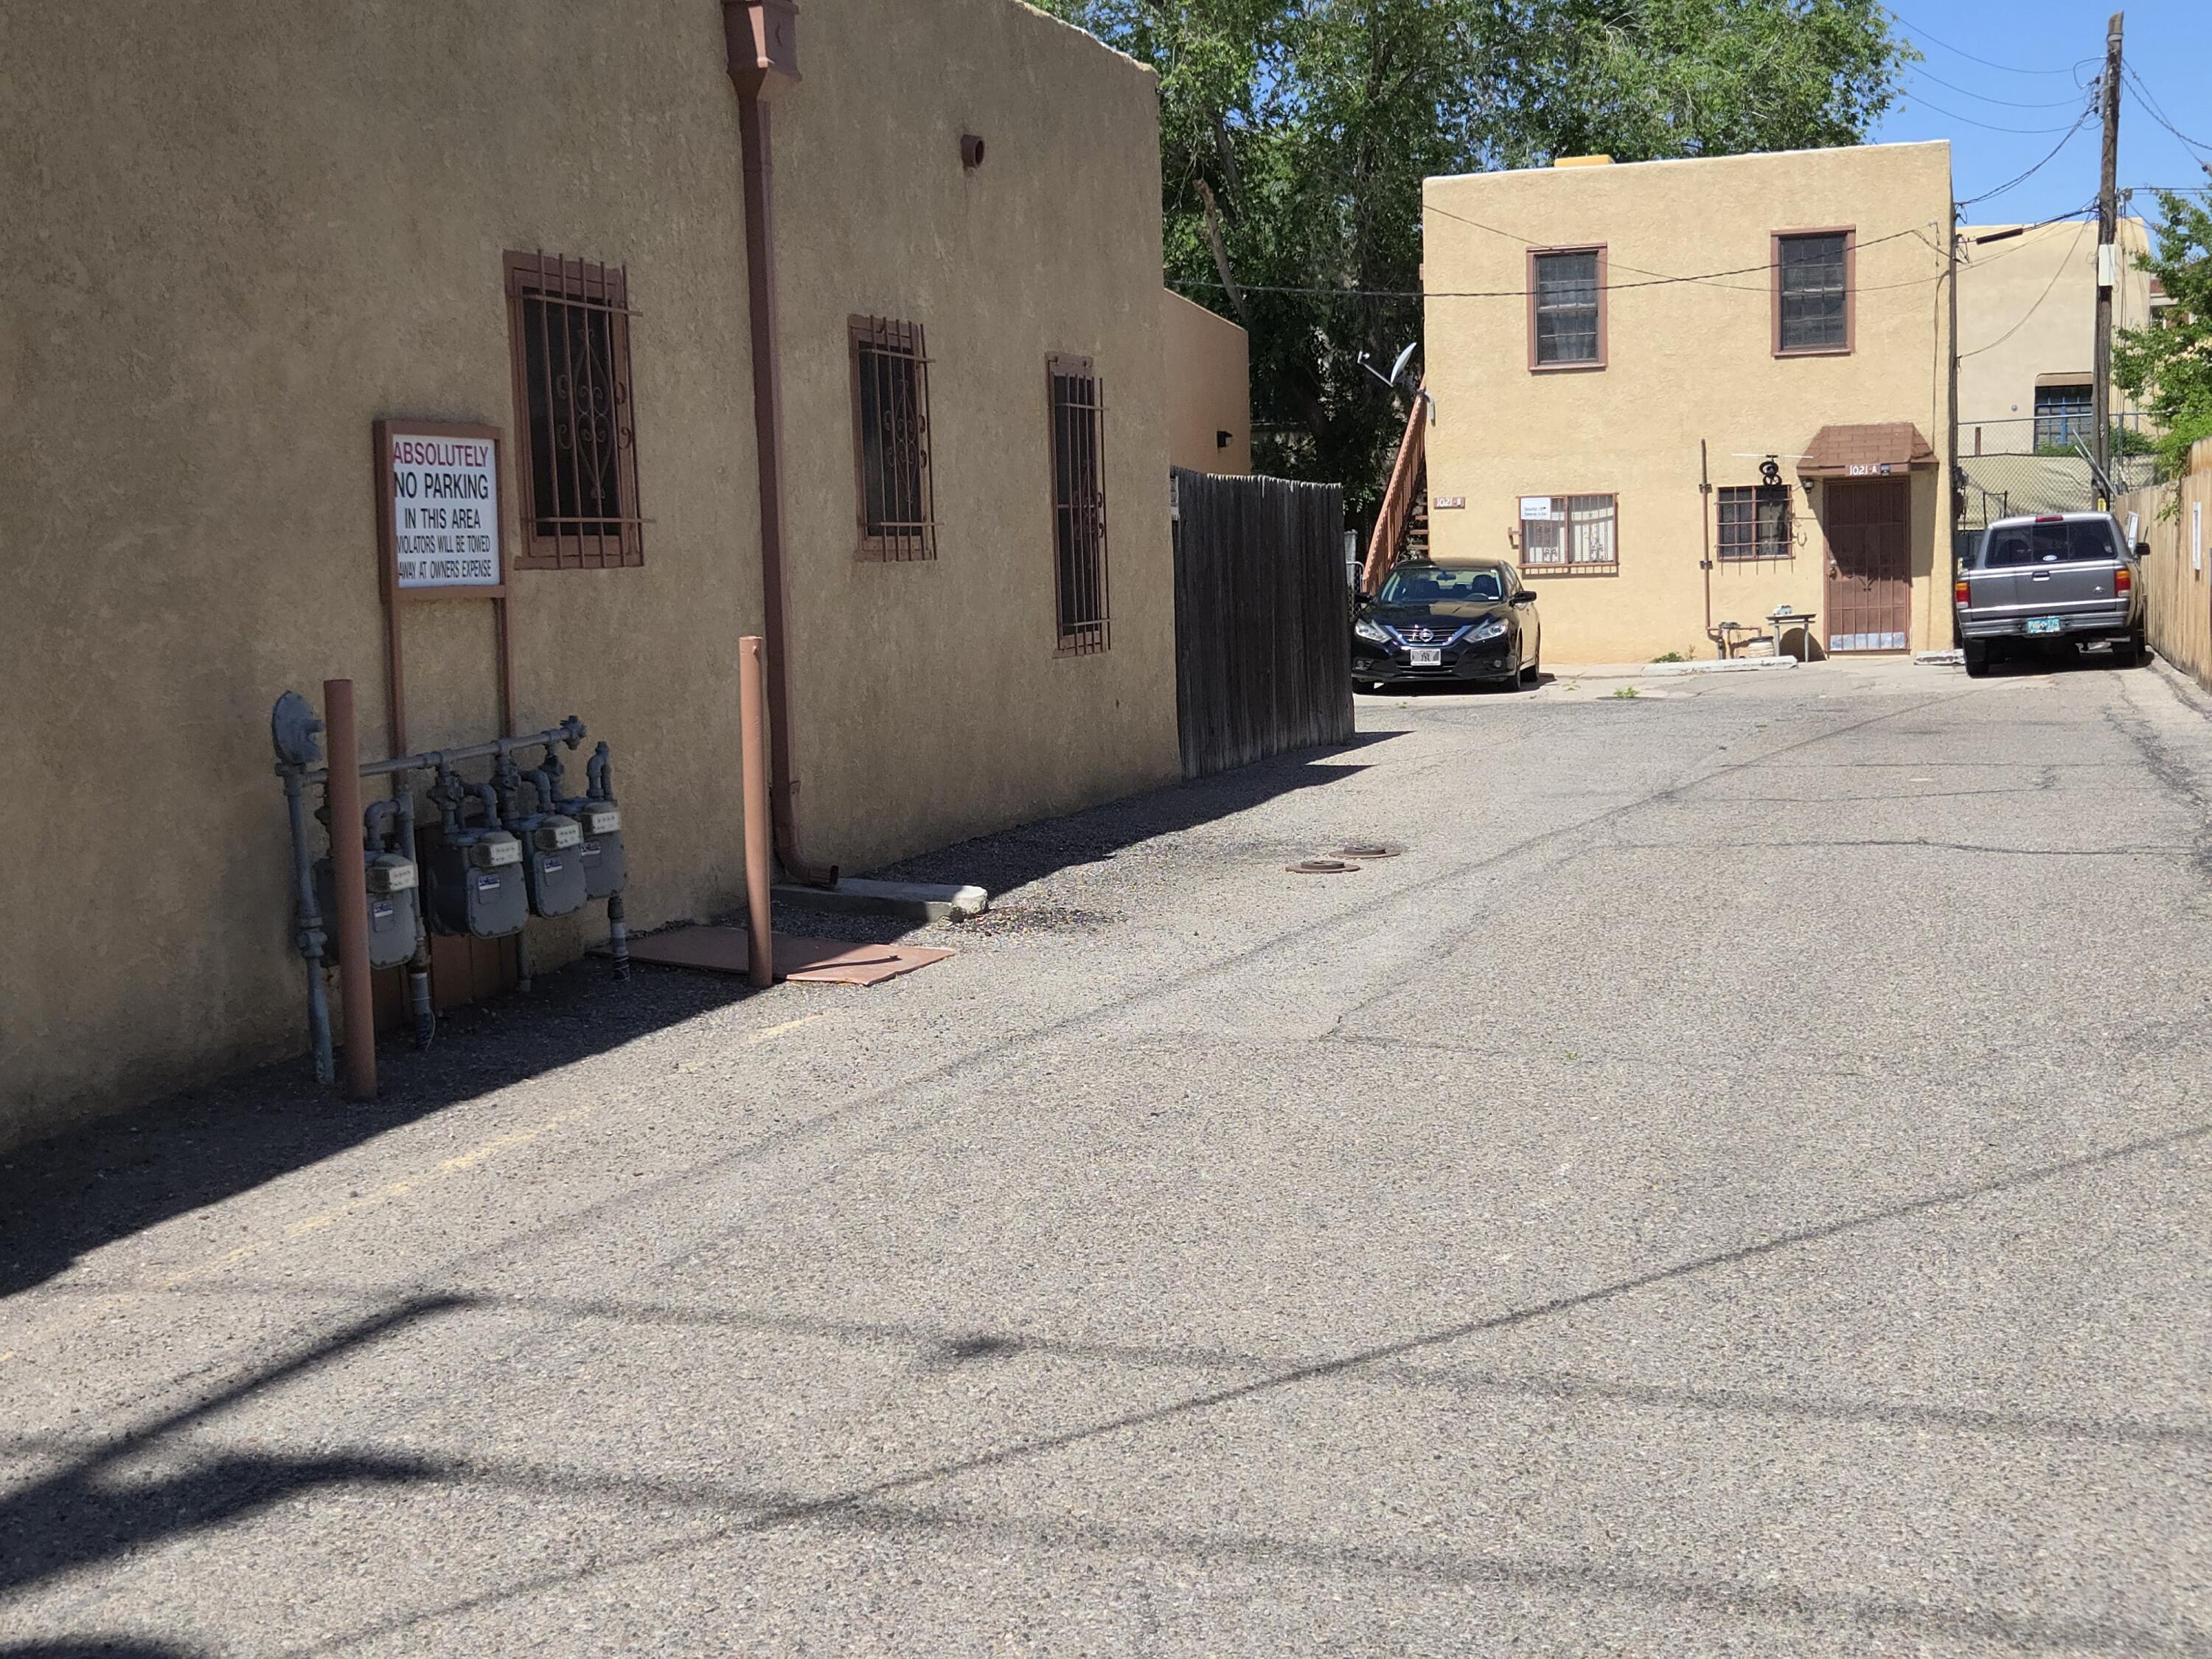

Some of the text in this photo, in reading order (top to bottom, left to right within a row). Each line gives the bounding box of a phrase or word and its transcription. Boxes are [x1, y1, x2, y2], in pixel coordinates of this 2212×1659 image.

[393, 441, 489, 467] ABSOLUTELY
[394, 471, 489, 500] NO PARKING
[405, 507, 481, 529] IN THIS AREA
[397, 535, 490, 554] VIOLATORS WILL BE TOWED
[398, 559, 492, 580] AWAY AT OWNERS EXPENSE
